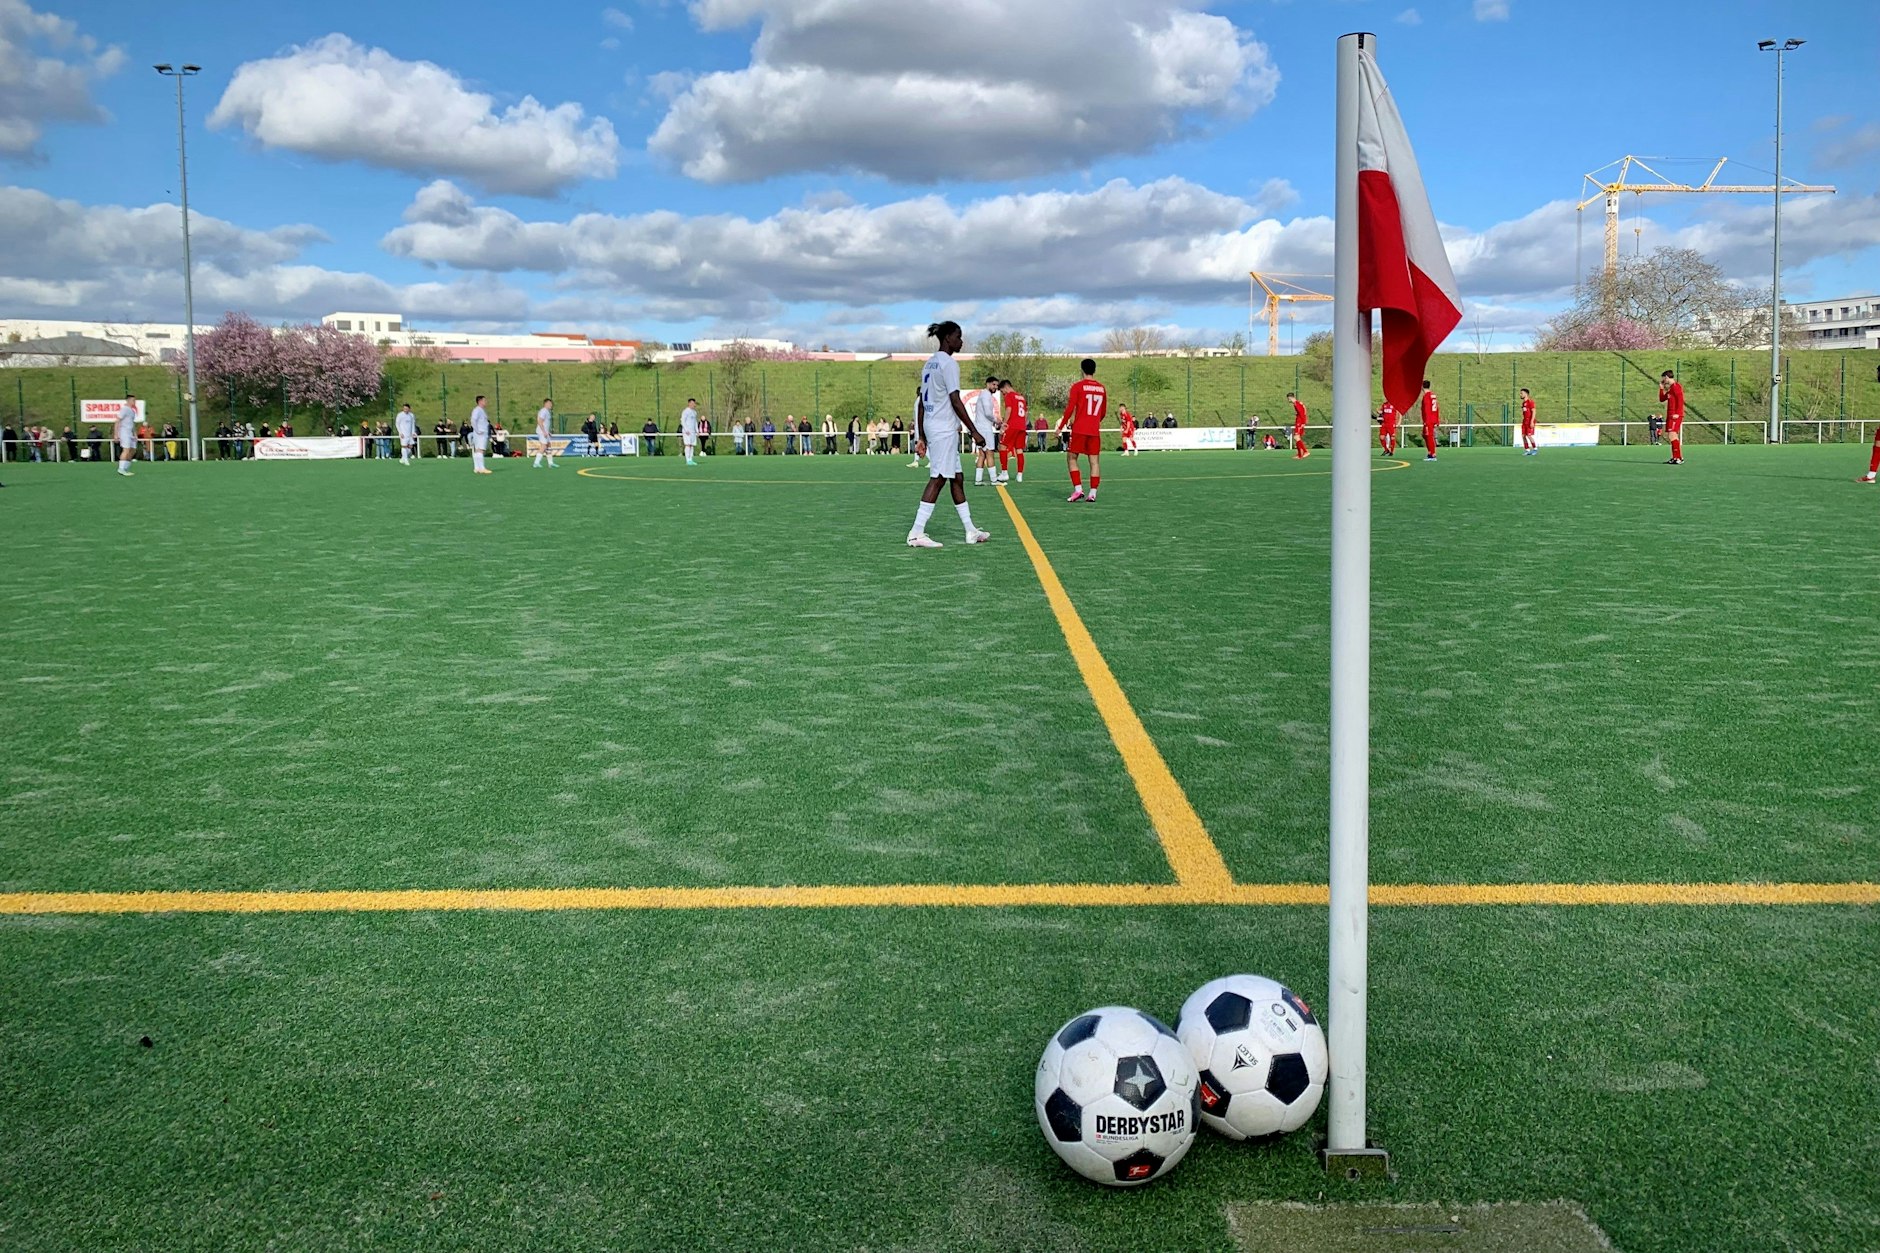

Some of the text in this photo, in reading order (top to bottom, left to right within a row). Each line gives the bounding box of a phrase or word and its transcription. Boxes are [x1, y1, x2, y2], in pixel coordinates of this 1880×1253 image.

[86, 403, 120, 411] SPARTA
[1018, 401, 1025, 417] 6
[1085, 394, 1103, 416] 17
[1198, 429, 1235, 442] ATB
[1237, 1043, 1259, 1066] SELECT
[1096, 1110, 1184, 1135] DERBYSTAR
